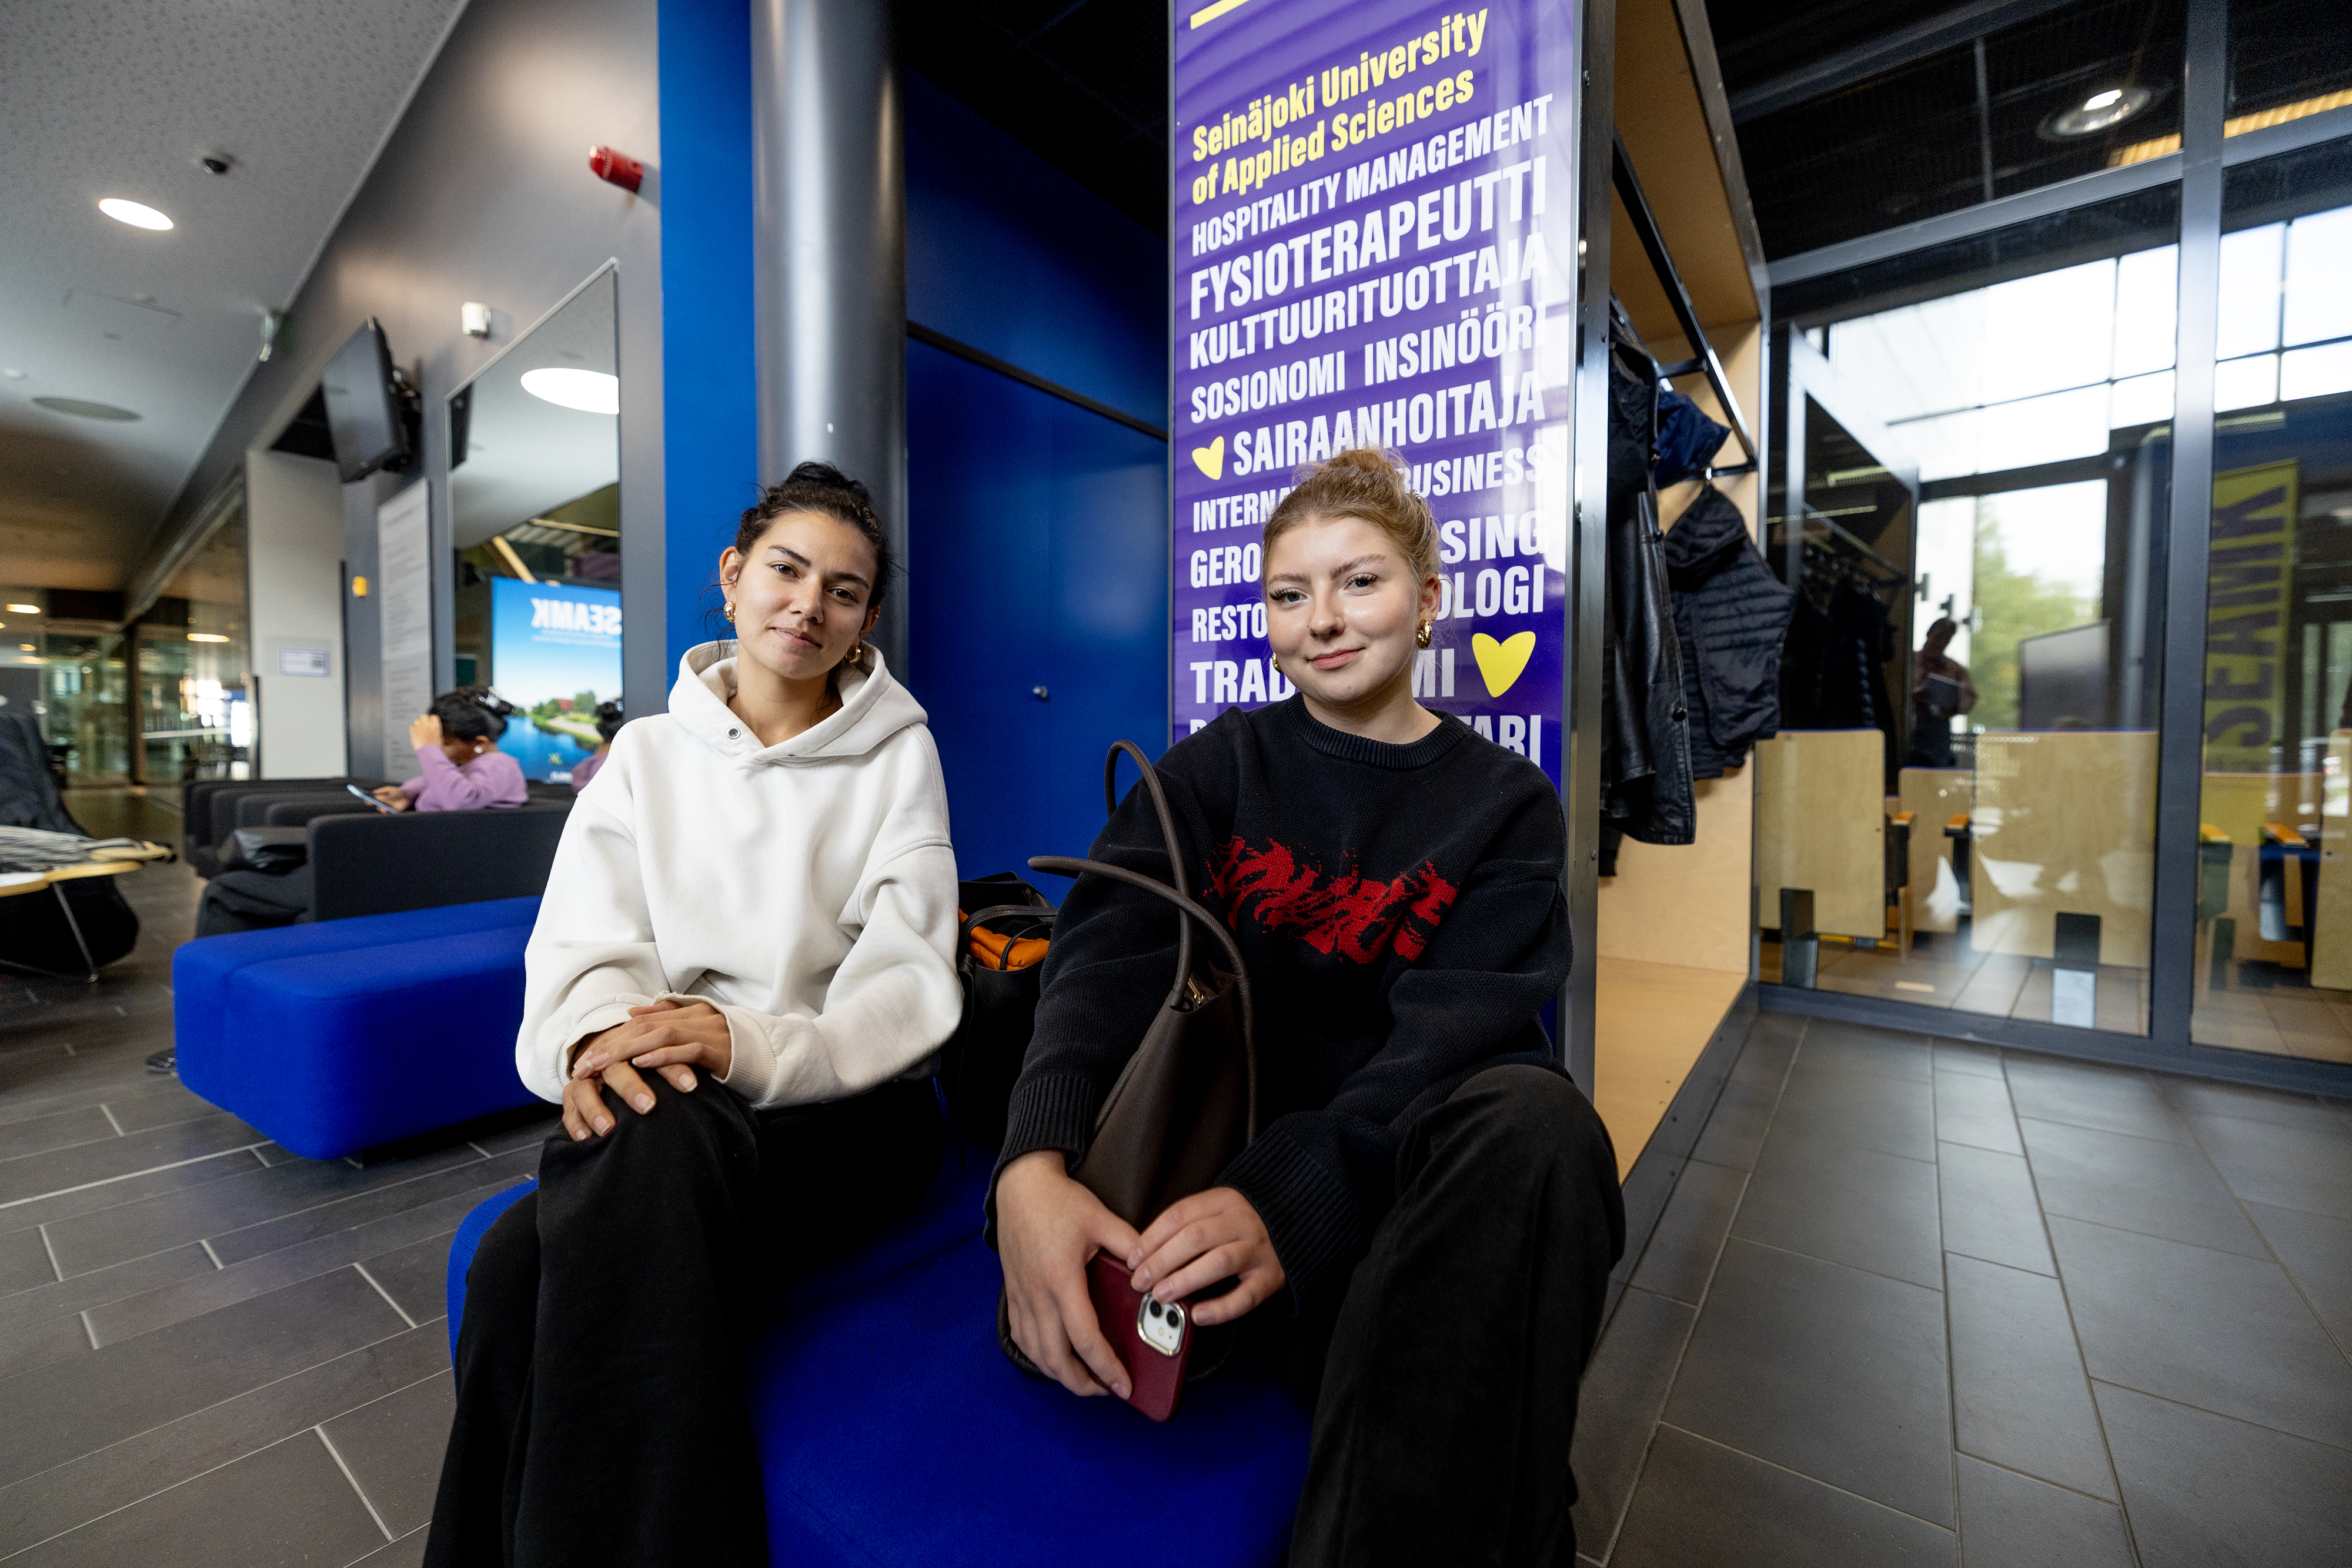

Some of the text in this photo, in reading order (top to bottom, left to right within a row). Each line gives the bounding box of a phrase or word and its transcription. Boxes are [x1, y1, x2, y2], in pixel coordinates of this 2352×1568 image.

[1192, 8, 1488, 162] Seinäjoki University
[1192, 69, 1474, 205] of Applied Sciences
[1191, 155, 1546, 320] FYSIOTERAPEUTTI
[1192, 93, 1553, 257] HOSPITALITY MANAGEMENT
[1190, 231, 1549, 370] KULTTUURITUOTTAJA
[1191, 300, 1546, 424] SOSIONOMI INSINÖÖRI
[1233, 370, 1545, 476] SAIRAANHOITAJA
[1190, 510, 1549, 589] GERO SING
[1192, 563, 1545, 642] RESTO OLOGI
